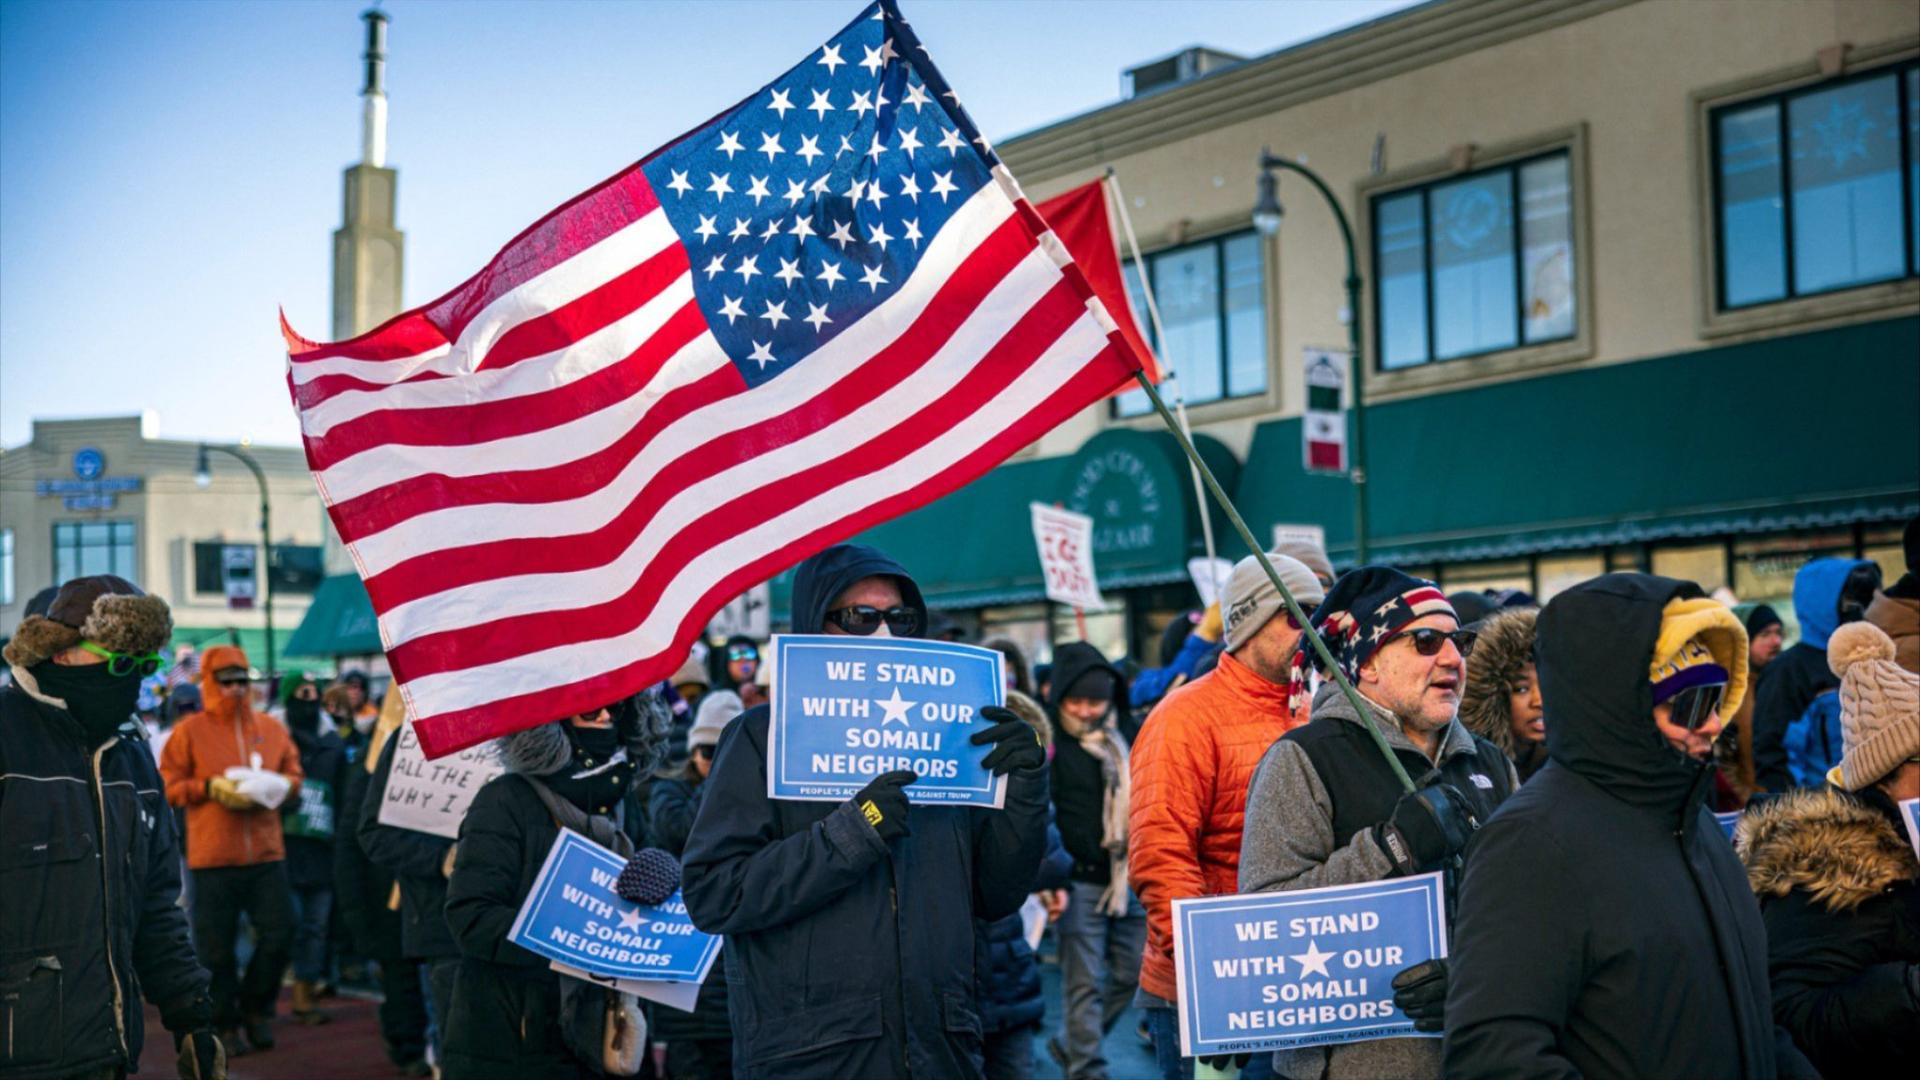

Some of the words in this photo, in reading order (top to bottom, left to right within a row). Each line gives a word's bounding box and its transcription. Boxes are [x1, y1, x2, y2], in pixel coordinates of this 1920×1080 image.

[826, 661, 867, 682] WE
[876, 663, 956, 686] STAND
[802, 698, 870, 718] WITH
[922, 702, 974, 724] OUR
[846, 728, 941, 752] SOMALI
[394, 758, 423, 778] ALL
[431, 764, 473, 789] THE
[812, 754, 958, 779] NEIGHBORS
[387, 786, 434, 808] WHY
[440, 793, 458, 813] I
[800, 786, 841, 795] PEOPLE'S
[561, 883, 614, 920] WITH
[651, 921, 697, 936] OUR
[583, 920, 663, 951] SOMALI
[1235, 920, 1279, 942] WE
[1289, 911, 1380, 937] STAND
[551, 925, 673, 967] NEIGHBORS
[1213, 955, 1285, 979] WITH
[1342, 945, 1403, 969] OUR
[1262, 977, 1367, 1004] SOMALI
[1228, 999, 1395, 1031] NEIGHBORS
[1218, 1040, 1261, 1051] PEOPLE'S
[1263, 1038, 1296, 1048] ACTION
[1347, 1028, 1384, 1039] AGAINST
